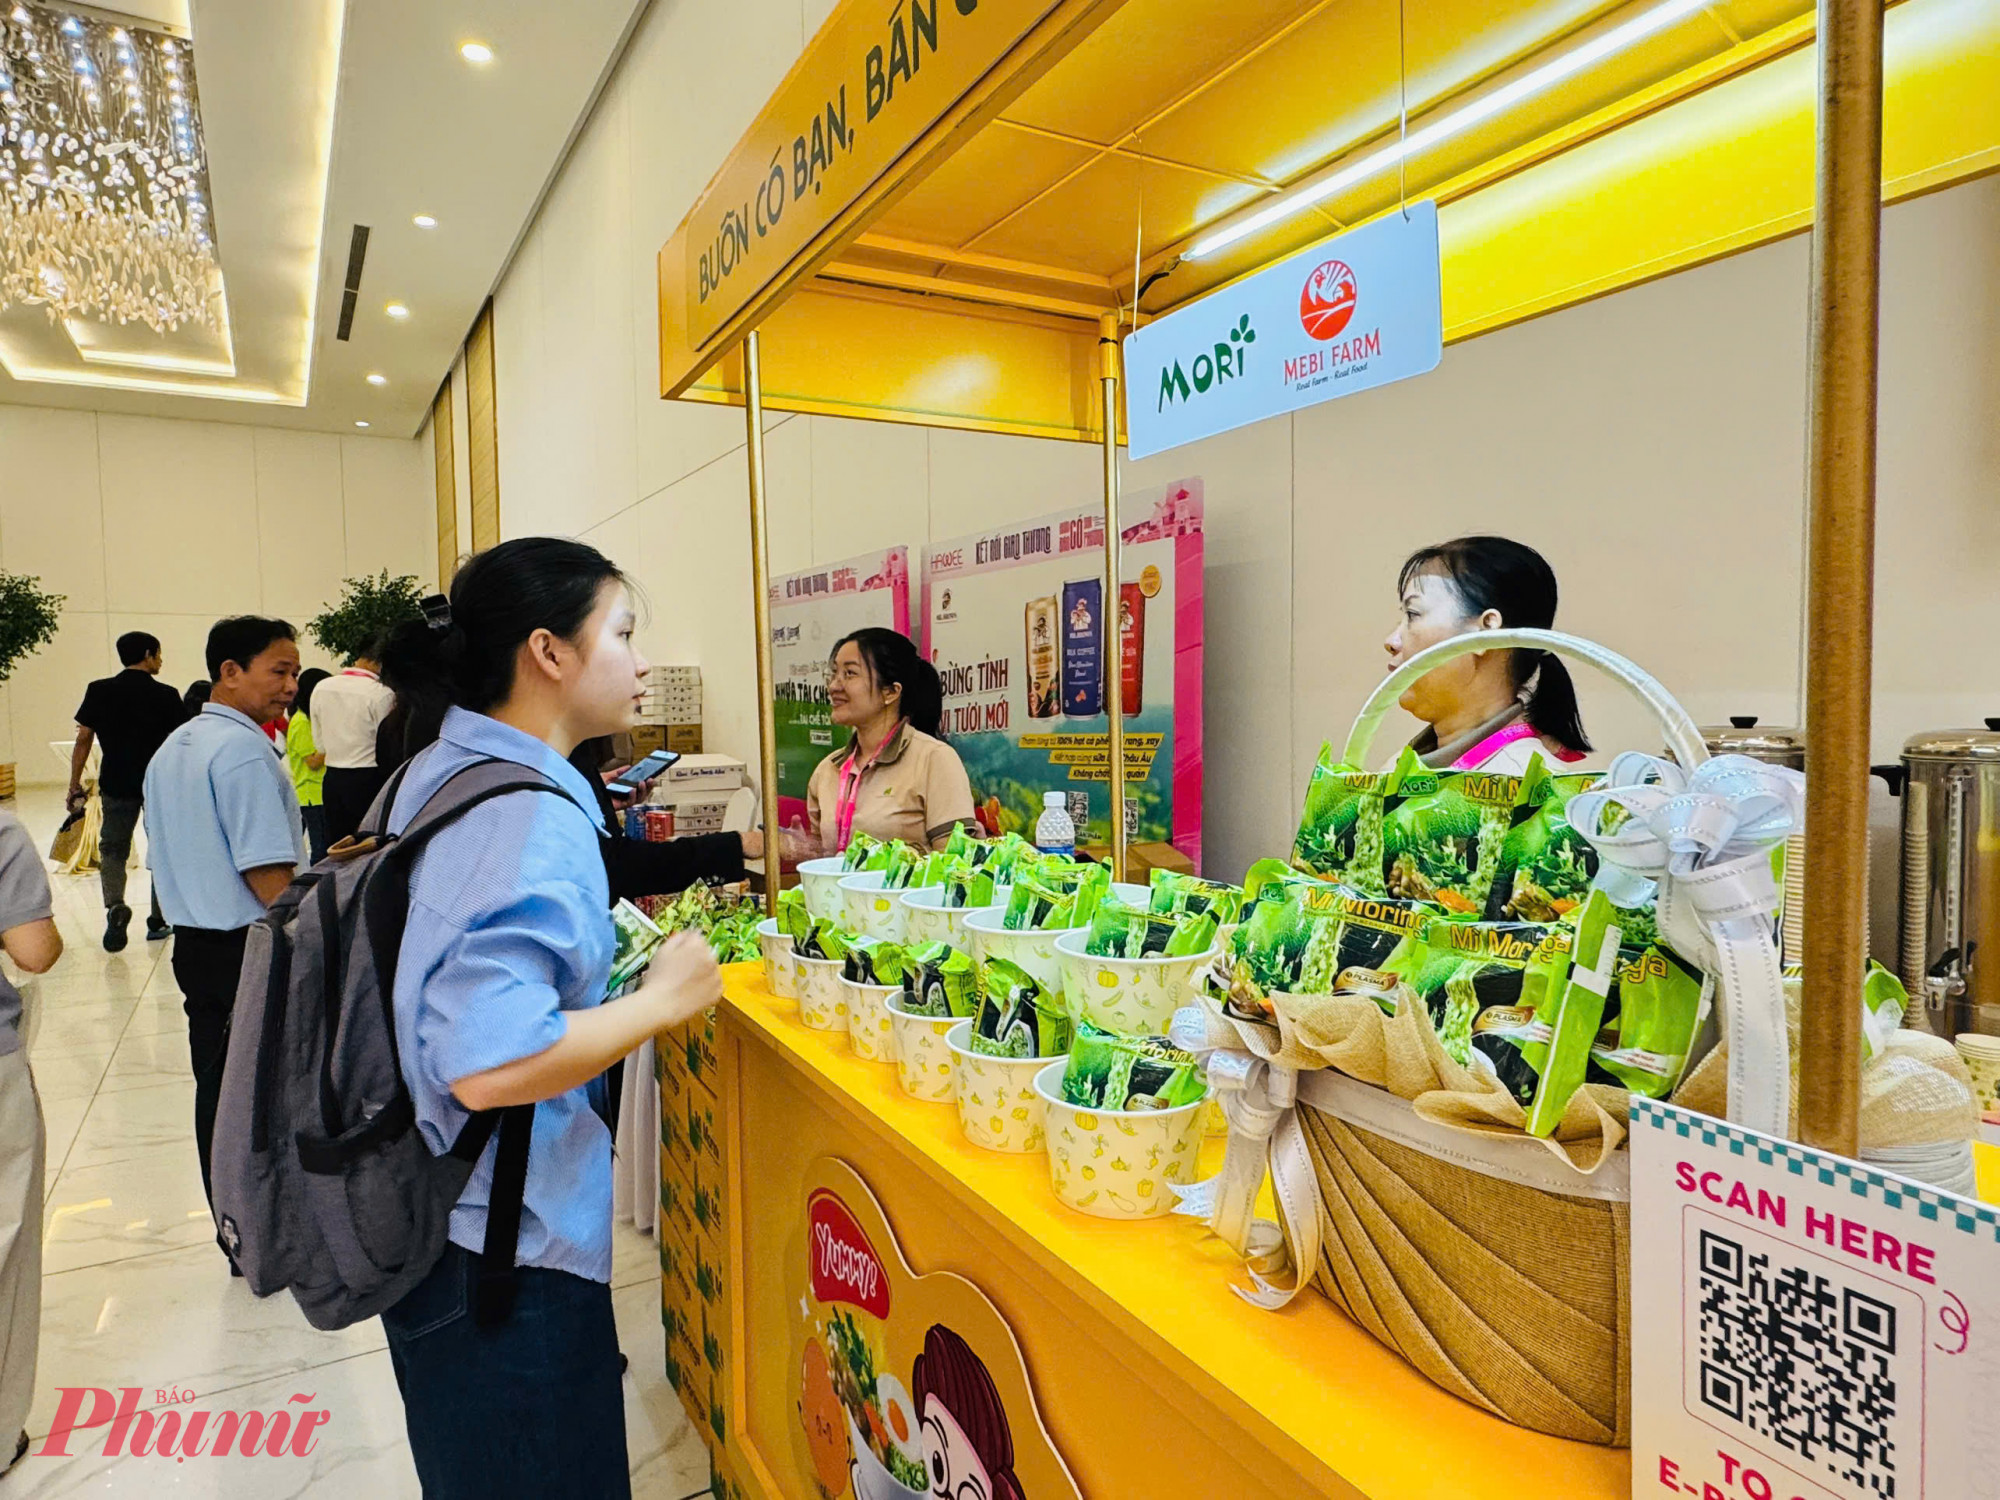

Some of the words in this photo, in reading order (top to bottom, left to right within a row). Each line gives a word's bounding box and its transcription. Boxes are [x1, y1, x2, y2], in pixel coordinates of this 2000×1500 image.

[755, 145, 785, 237] CÓ
[793, 84, 854, 201] BẠN,
[865, 0, 938, 123] BÁN
[1284, 350, 1324, 386] MEBI
[1331, 327, 1381, 368] FARM
[985, 694, 1009, 730] MỚI
[1337, 897, 1429, 939] Moring
[1451, 924, 1481, 951] Mì
[1493, 1012, 1523, 1023] PLASMA
[1675, 1161, 1787, 1228] SCAN
[1805, 1206, 1937, 1285] HERE
[1717, 1449, 1773, 1500] TO
